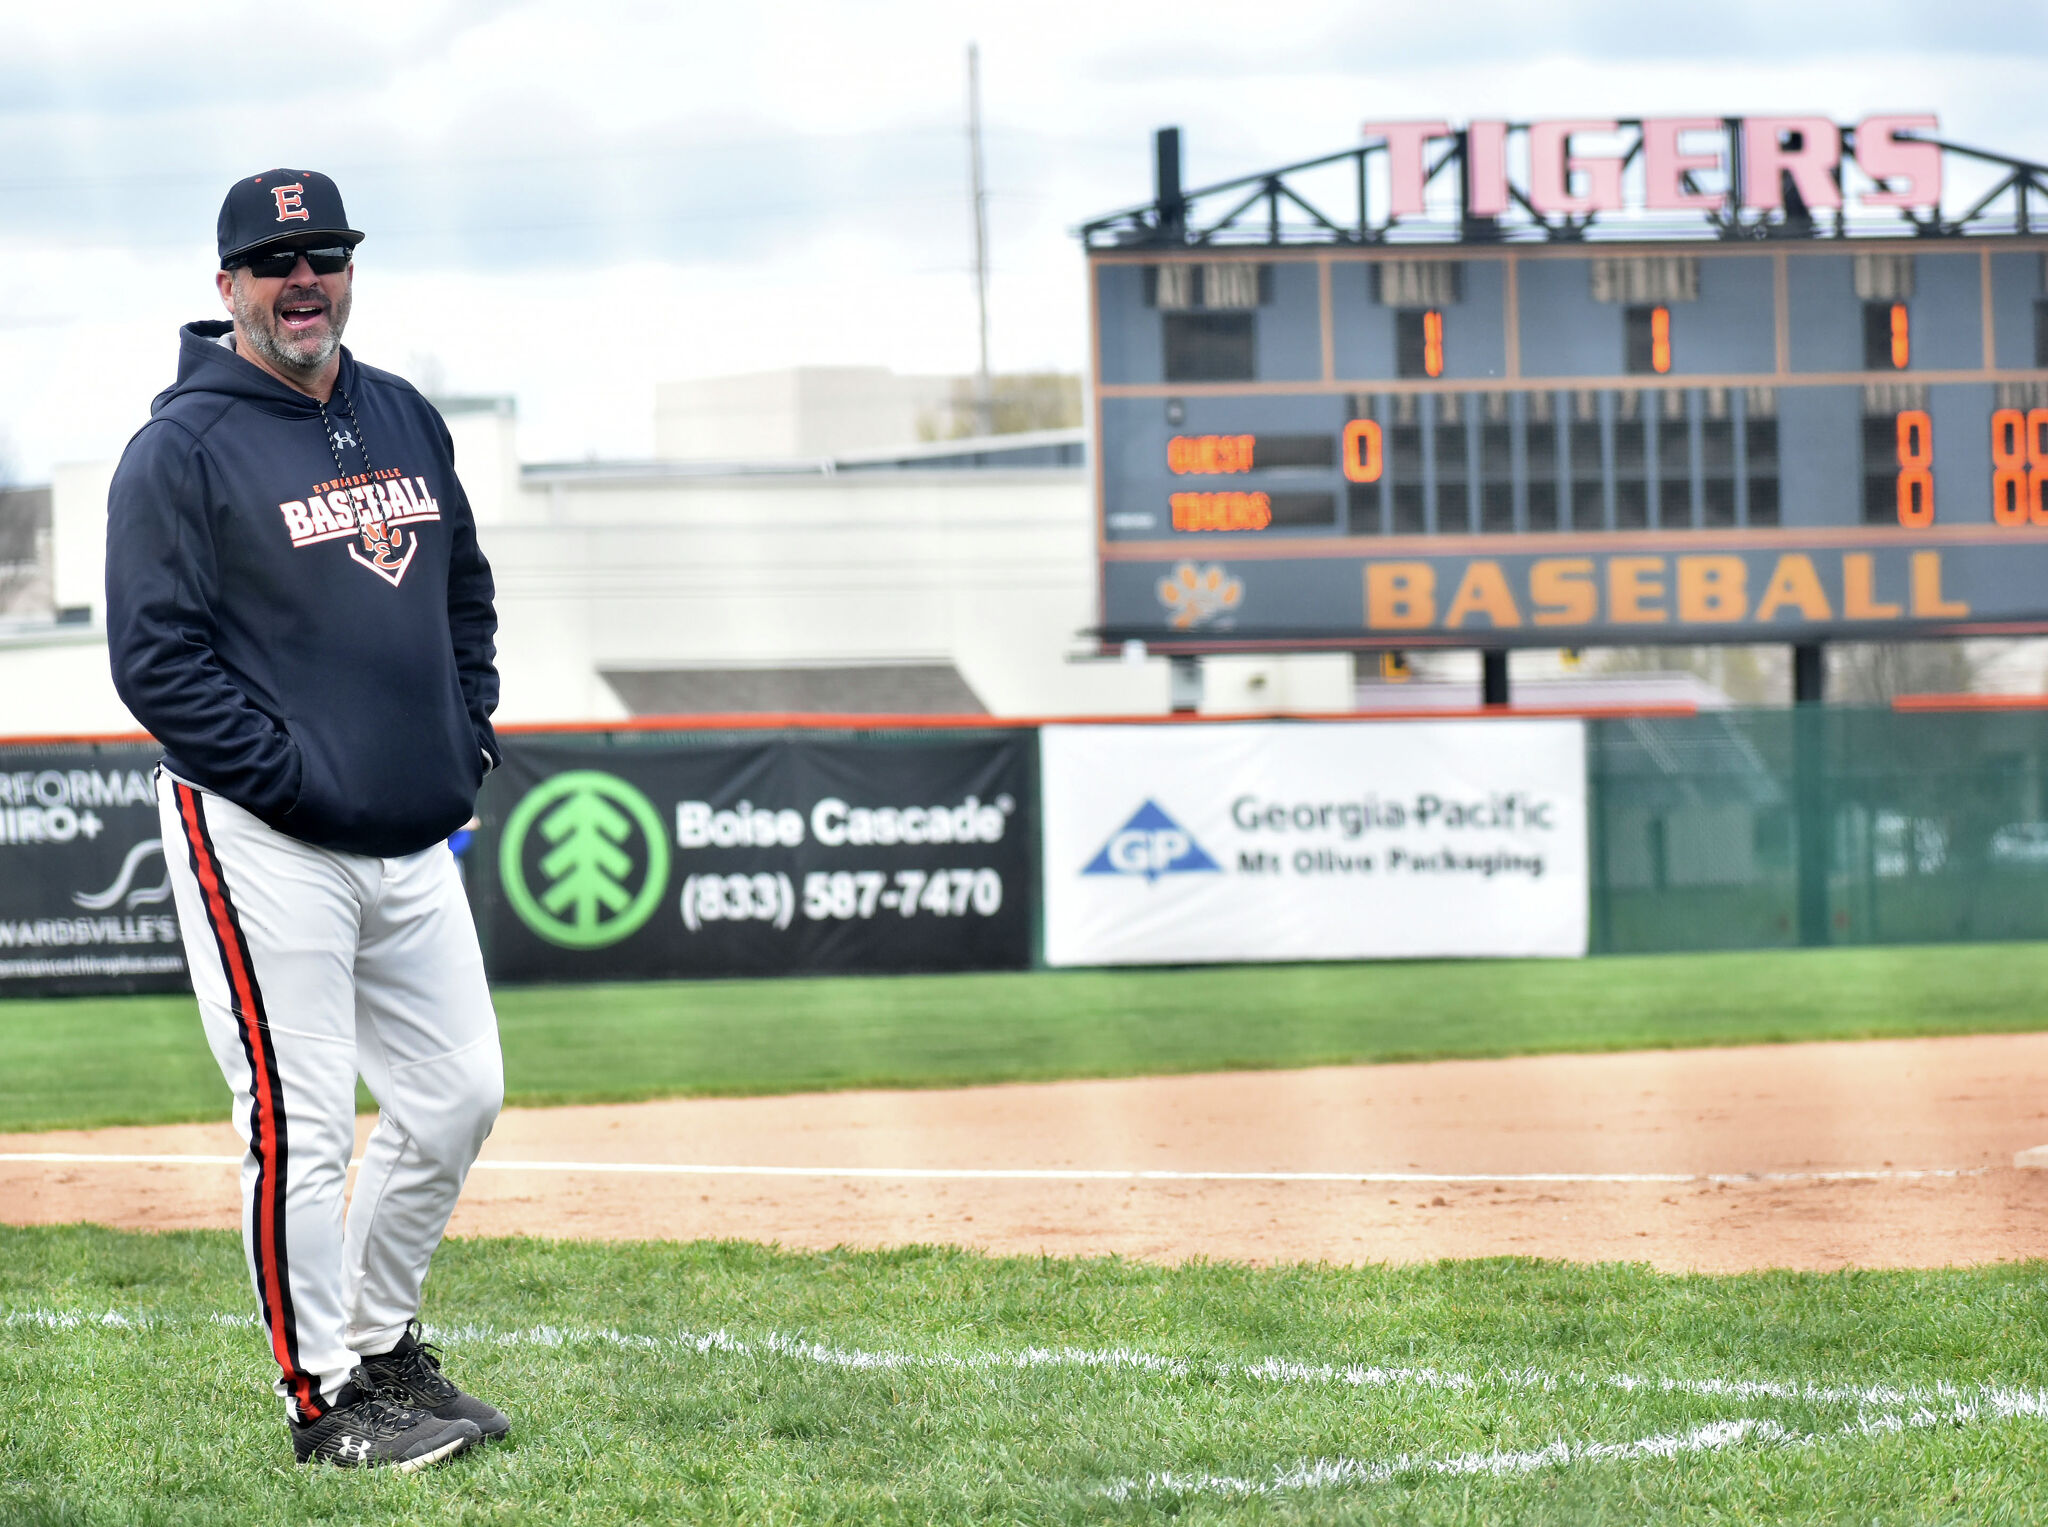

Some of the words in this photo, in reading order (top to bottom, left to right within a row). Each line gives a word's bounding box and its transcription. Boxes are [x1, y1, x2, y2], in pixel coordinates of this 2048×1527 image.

[1363, 114, 1942, 217] TIGERS
[271, 182, 310, 222] E
[1343, 419, 1382, 482] 0
[1897, 410, 1933, 469] 0
[279, 476, 440, 541] BASEBALL
[1897, 469, 1934, 528] 0
[1364, 551, 1970, 629] BASEBALL
[0, 806, 103, 845] IRO+
[676, 801, 802, 849] Boise
[811, 796, 1004, 847] Cascade
[1231, 792, 1554, 838] Georgia-Pacific
[1106, 830, 1190, 873] GP
[1237, 849, 1280, 875] Mt
[1293, 849, 1373, 875] Olive
[1387, 848, 1545, 878] Packaging
[680, 871, 795, 931] (833)
[802, 868, 1002, 920] 587-7470
